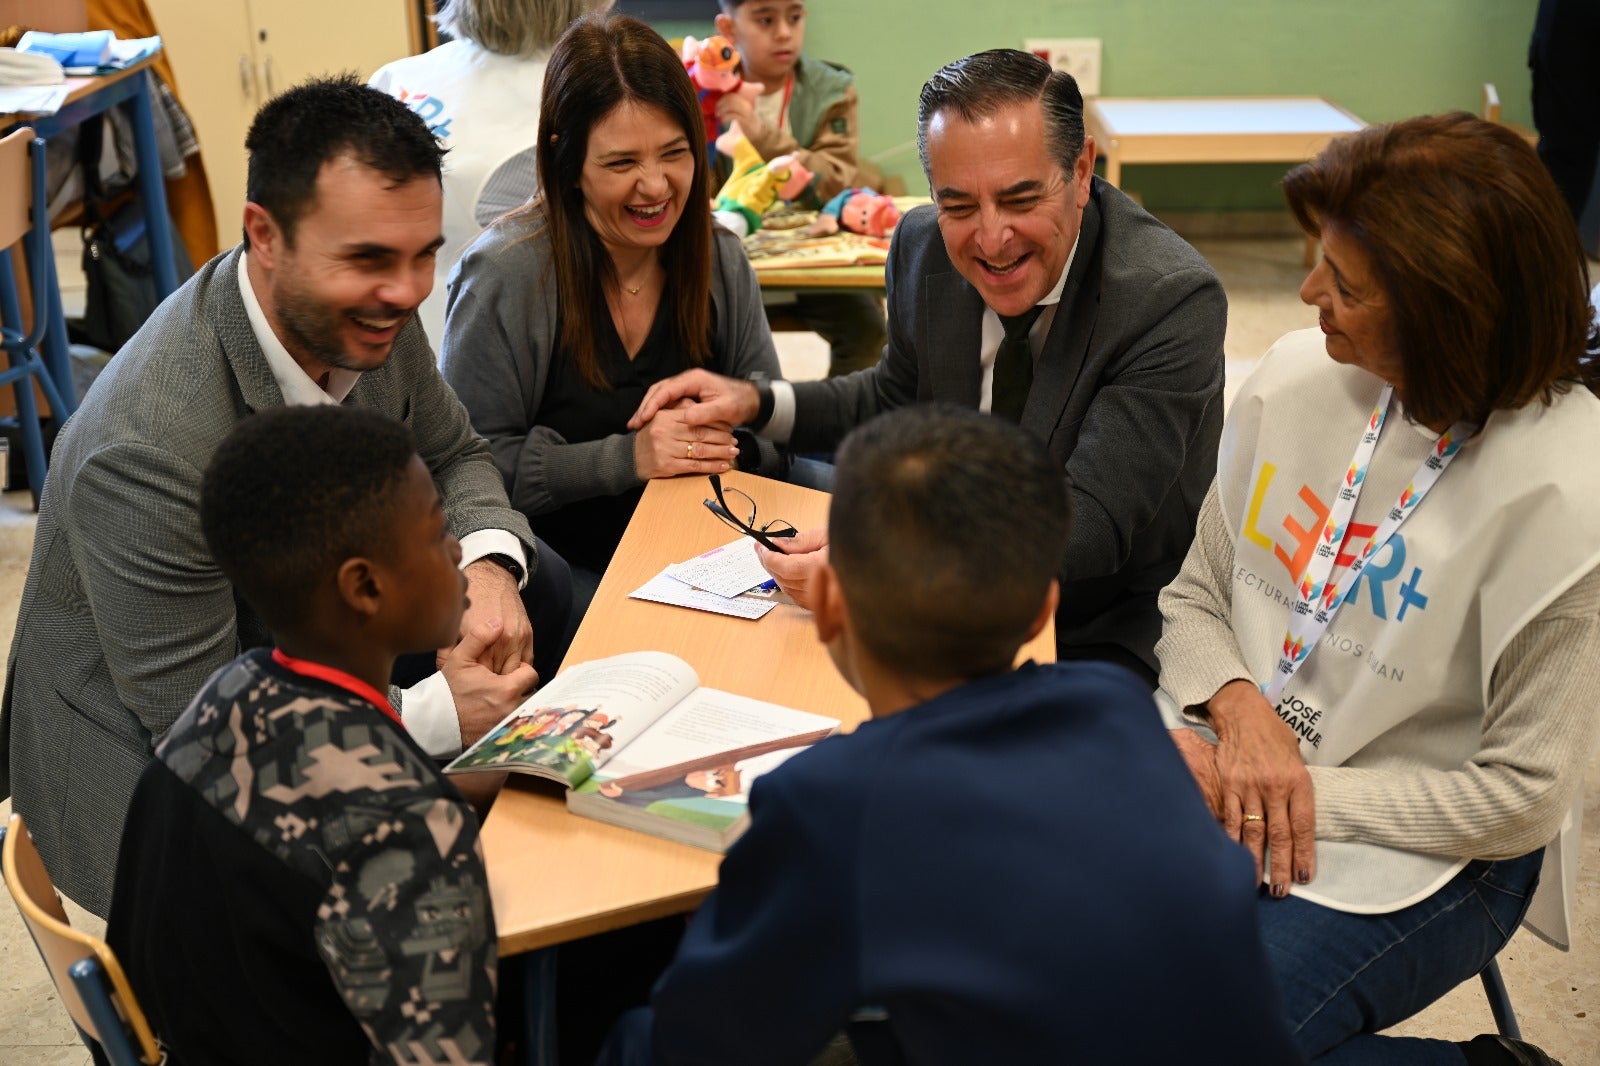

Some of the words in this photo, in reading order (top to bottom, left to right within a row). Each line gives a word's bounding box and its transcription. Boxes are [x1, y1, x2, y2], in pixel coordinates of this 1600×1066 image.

[1326, 632, 1363, 657] NOS
[1282, 695, 1322, 725] JOSÉ
[1275, 704, 1322, 750] MANUE
